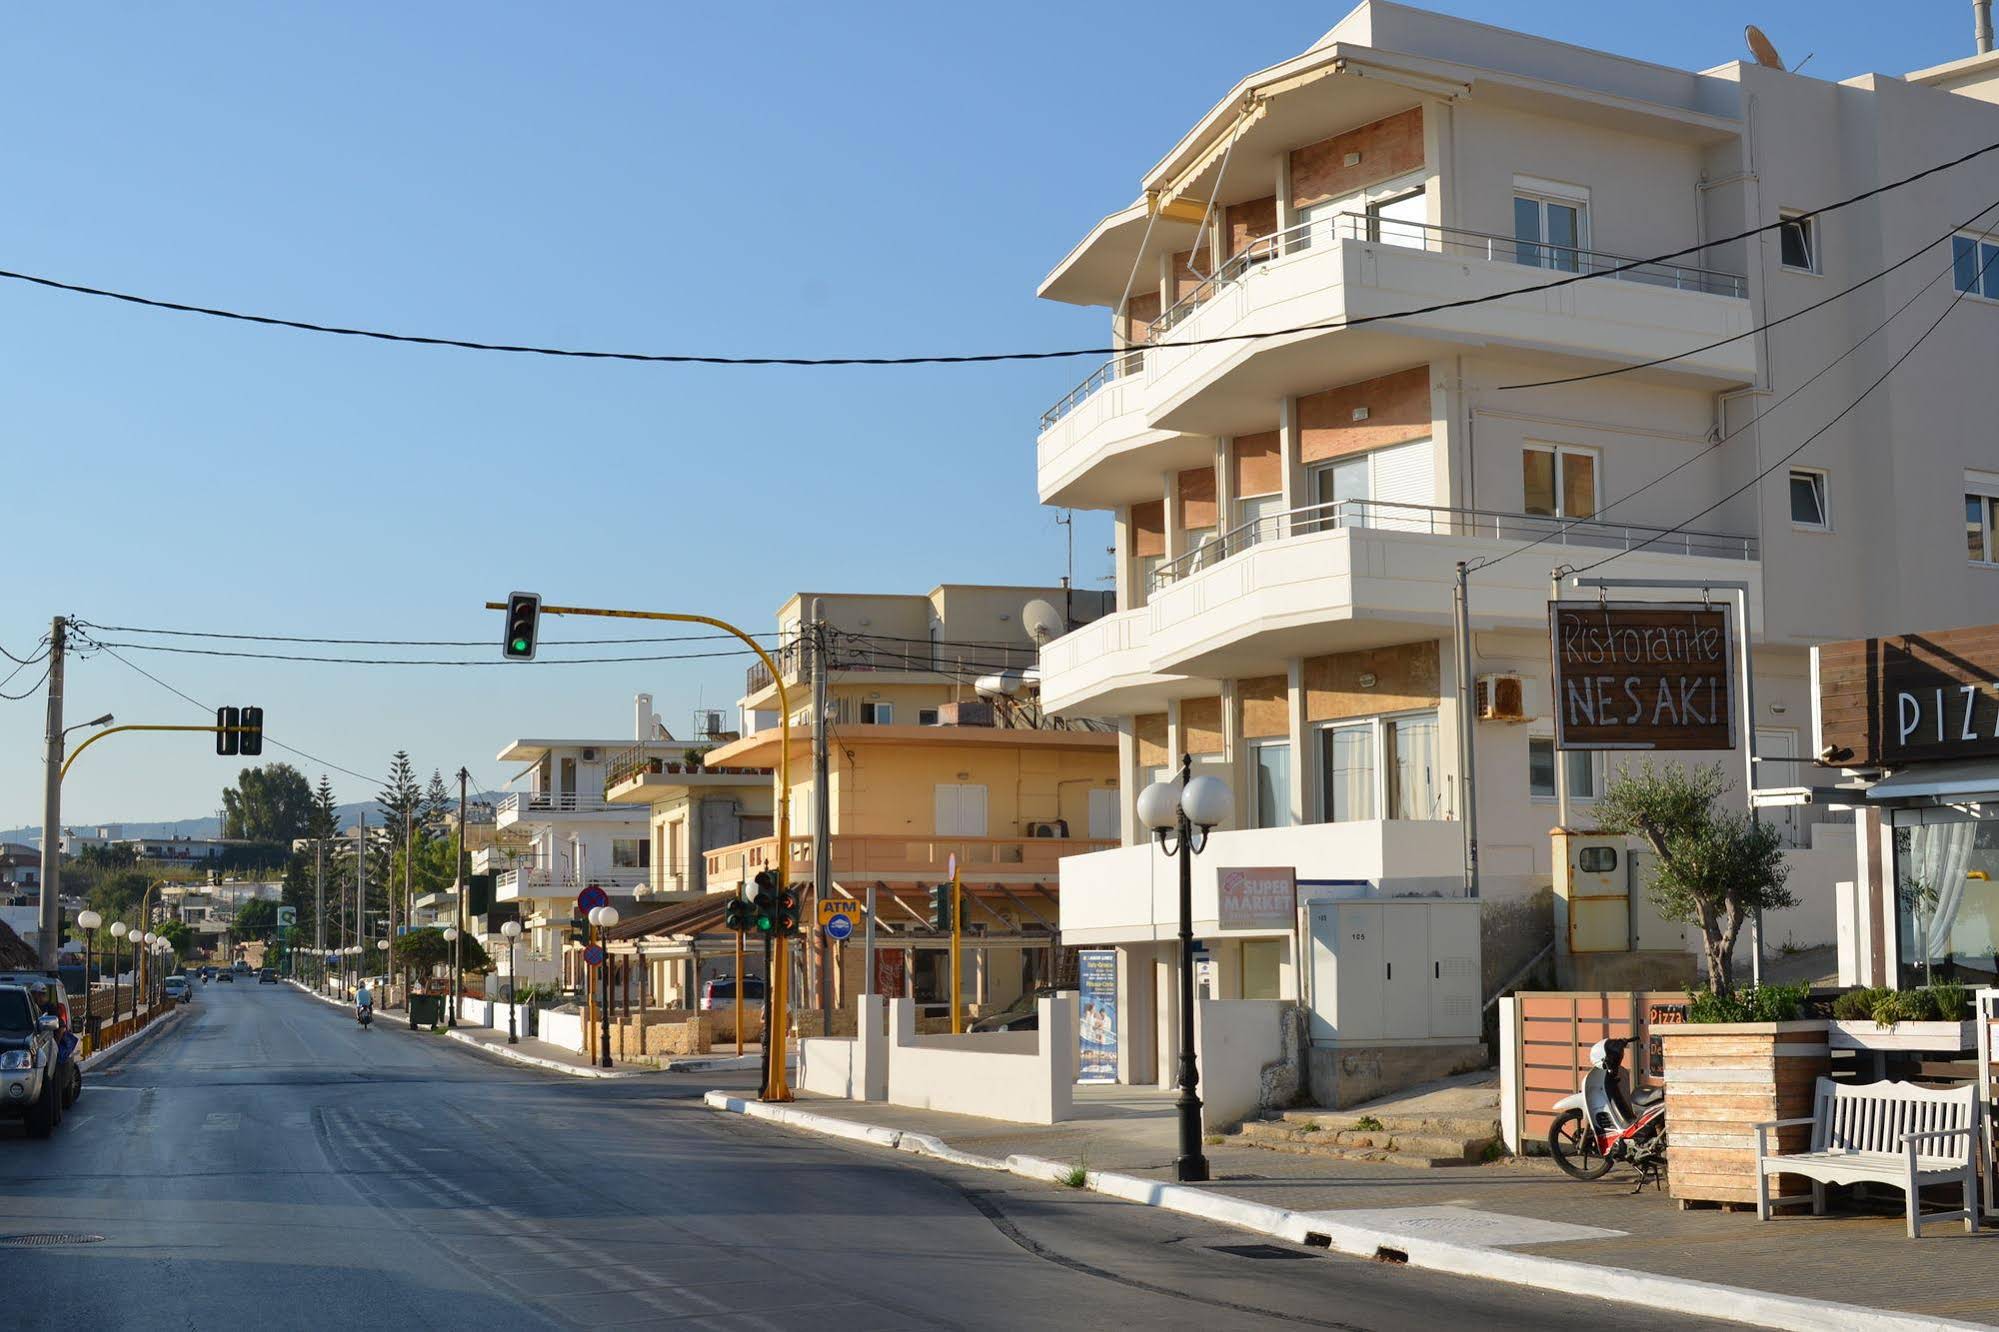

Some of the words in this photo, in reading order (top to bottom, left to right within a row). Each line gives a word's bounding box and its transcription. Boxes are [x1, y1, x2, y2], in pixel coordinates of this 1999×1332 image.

[1564, 613, 1719, 663] Ristorante
[1567, 677, 1717, 725] NESAKI
[1243, 880, 1289, 895] SUPER
[824, 902, 857, 912] ATM
[1223, 896, 1291, 912] MARKET
[1351, 933, 1366, 941] 105
[1651, 1008, 1682, 1025] Pizza
